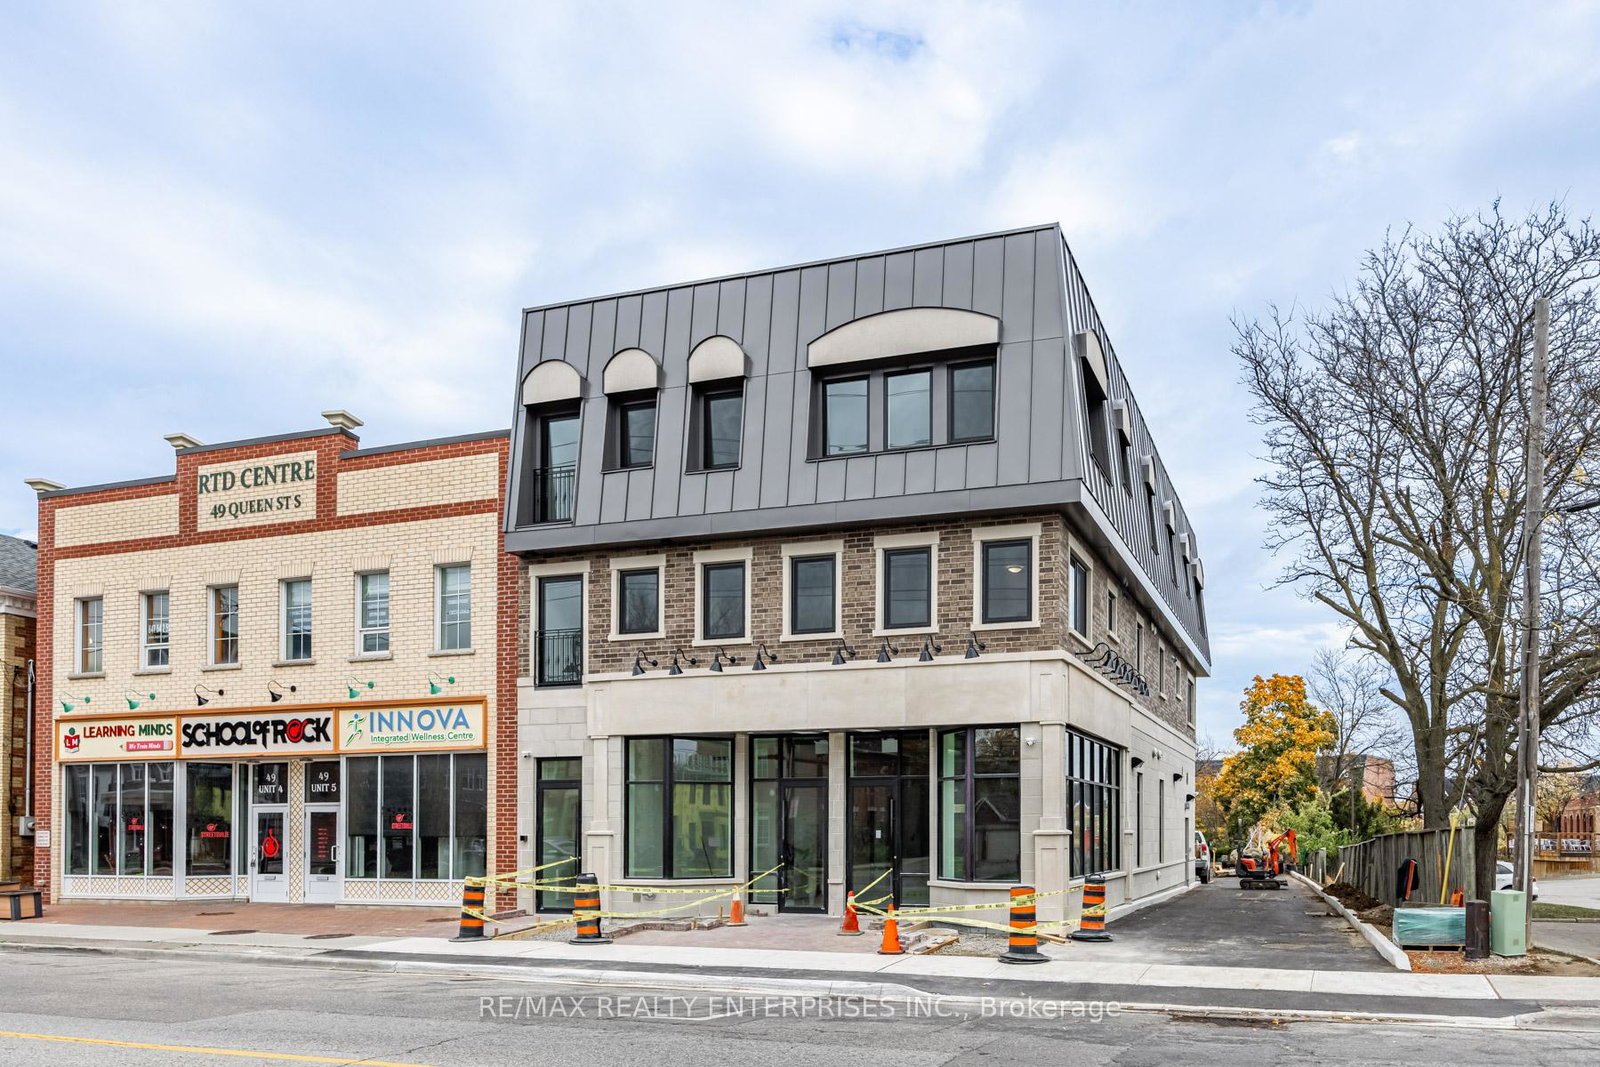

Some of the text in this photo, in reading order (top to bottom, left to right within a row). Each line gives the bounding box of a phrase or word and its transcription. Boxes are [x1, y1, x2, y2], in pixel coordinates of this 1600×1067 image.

[198, 459, 315, 495] RTD CENTRE
[210, 494, 302, 519] 49 QUEEN ST S
[369, 707, 470, 733] INNOVA
[83, 723, 173, 739] LEARNING MINDS
[182, 721, 257, 748] SCHOOL
[271, 717, 331, 744] ROCK
[370, 731, 474, 743] Integrated Wellness Centre
[265, 773, 276, 783] 49
[318, 771, 329, 782] 49
[258, 784, 283, 793] UNIT 4
[311, 783, 337, 793] UNIT 5
